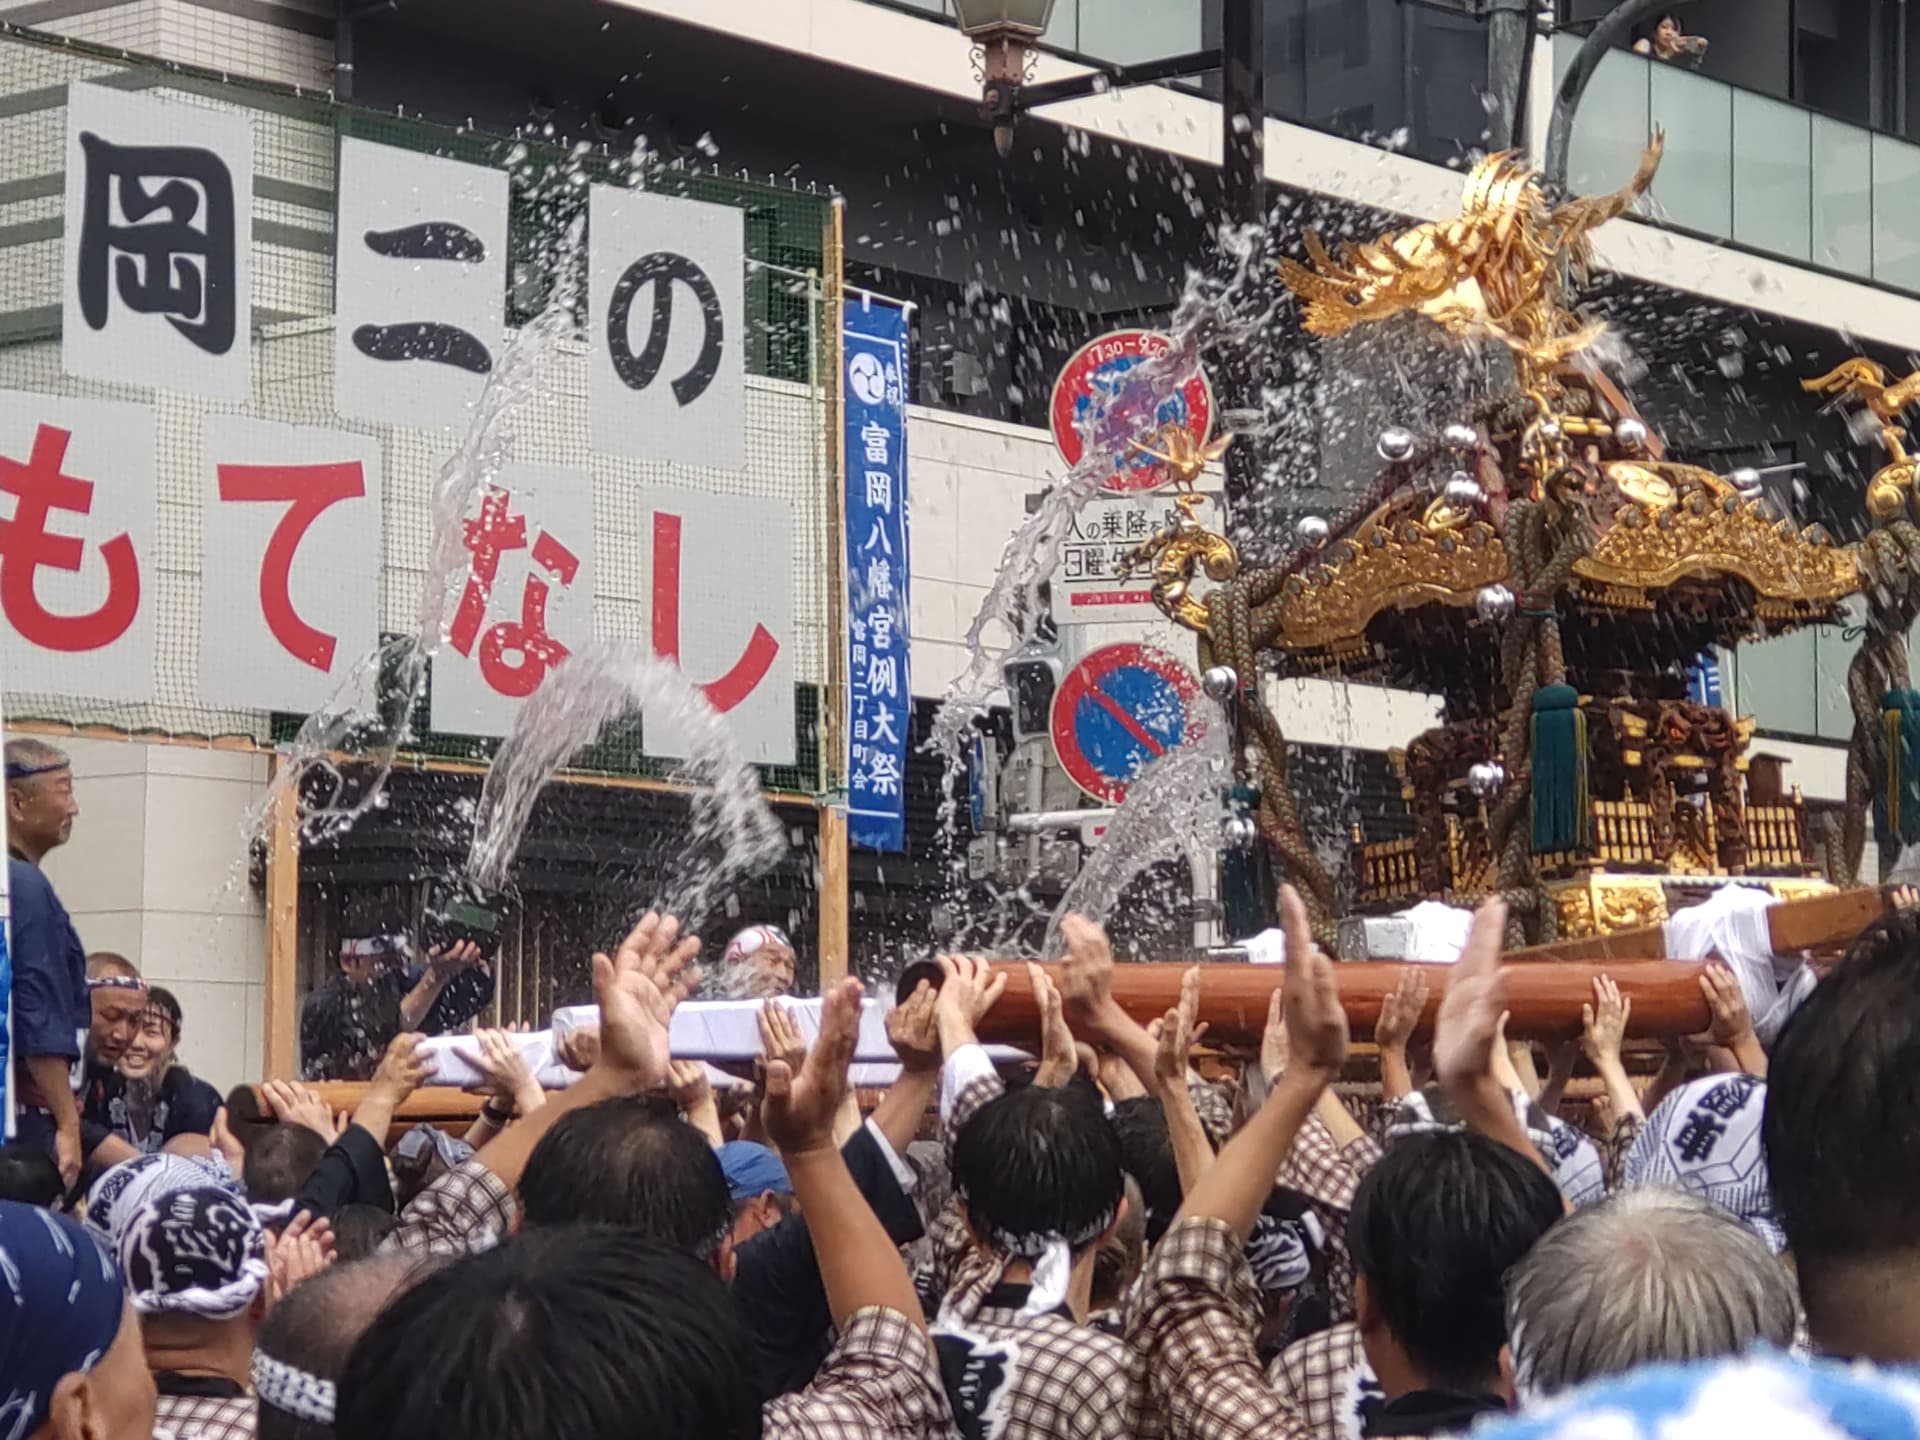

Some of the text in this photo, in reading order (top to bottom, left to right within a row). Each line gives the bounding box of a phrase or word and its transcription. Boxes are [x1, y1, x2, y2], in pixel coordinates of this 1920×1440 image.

[851, 618, 870, 790] 富岡二丁目町会
[861, 420, 901, 796] 富岡八幡宮例大祭
